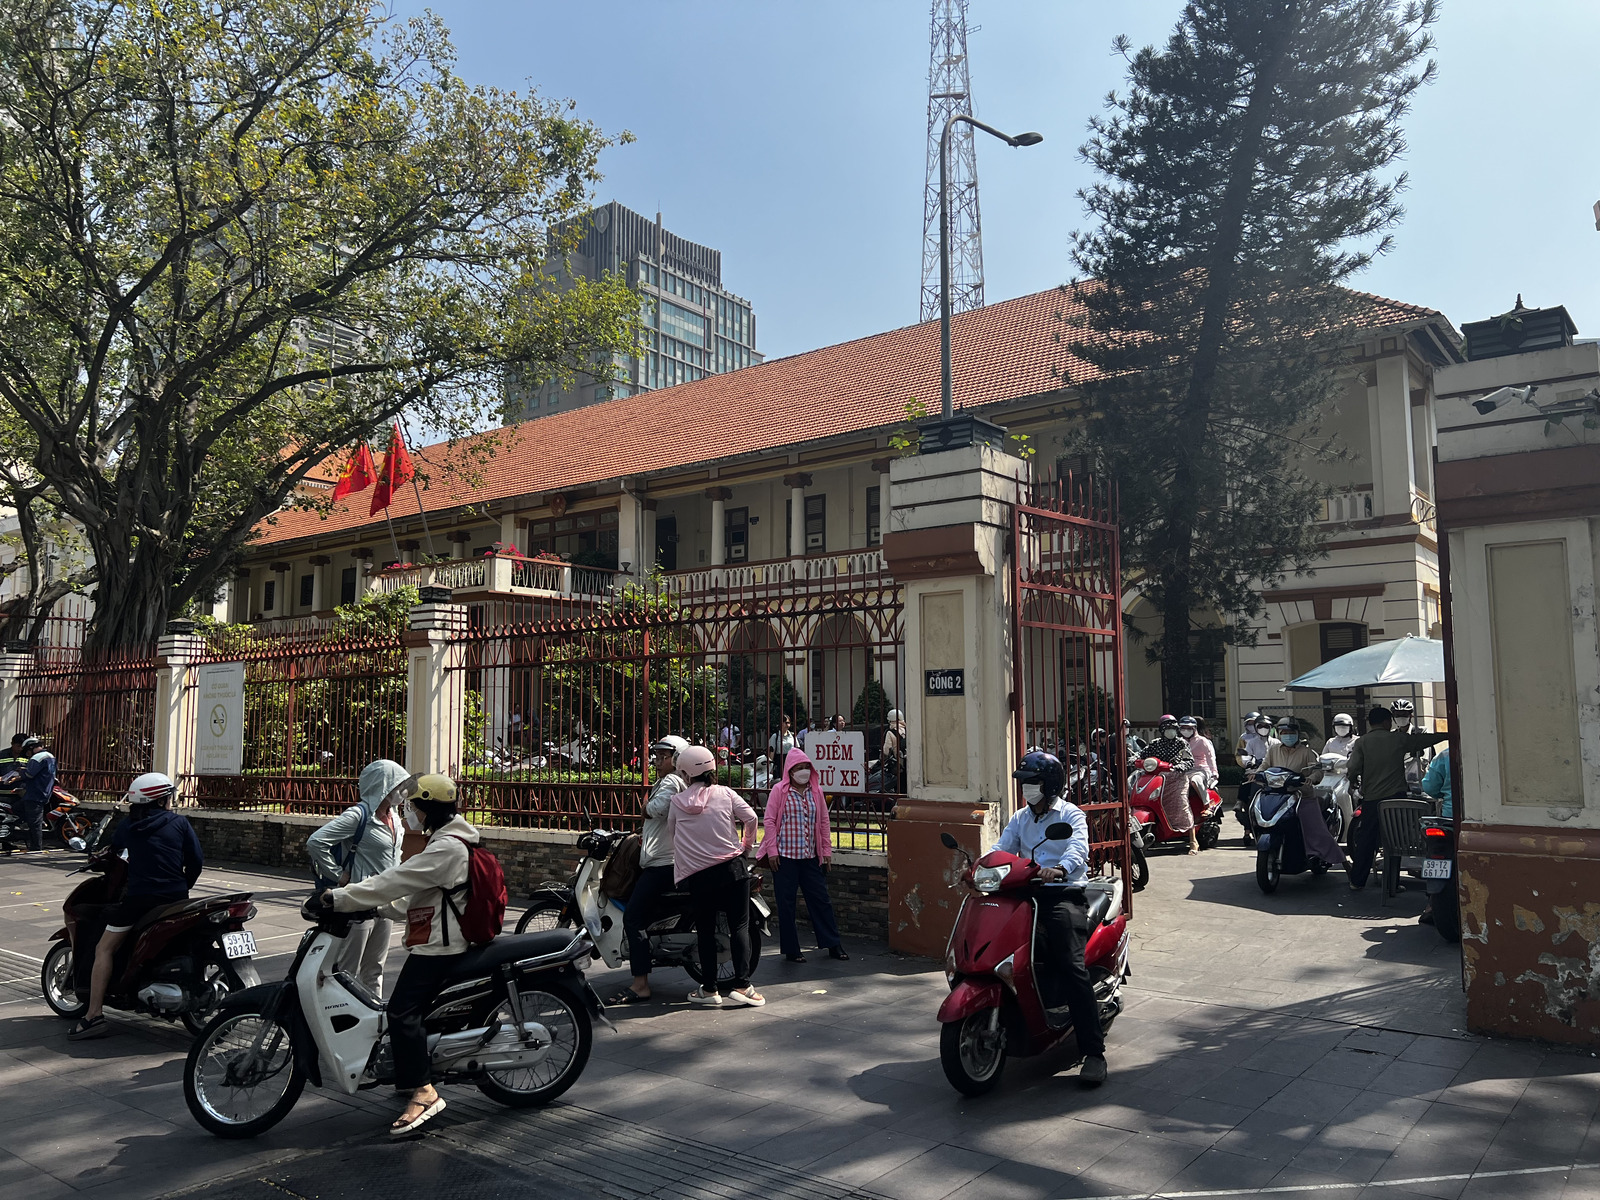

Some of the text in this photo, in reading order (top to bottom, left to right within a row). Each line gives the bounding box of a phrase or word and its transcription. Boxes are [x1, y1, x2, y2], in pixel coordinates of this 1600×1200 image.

[955, 675, 962, 689] 2
[815, 735, 854, 761] ĐIỂM
[816, 765, 860, 787] IỮ XE
[1426, 860, 1448, 869] 59-T2
[227, 932, 251, 946] 59-T2
[324, 1002, 349, 1011] HONDA
